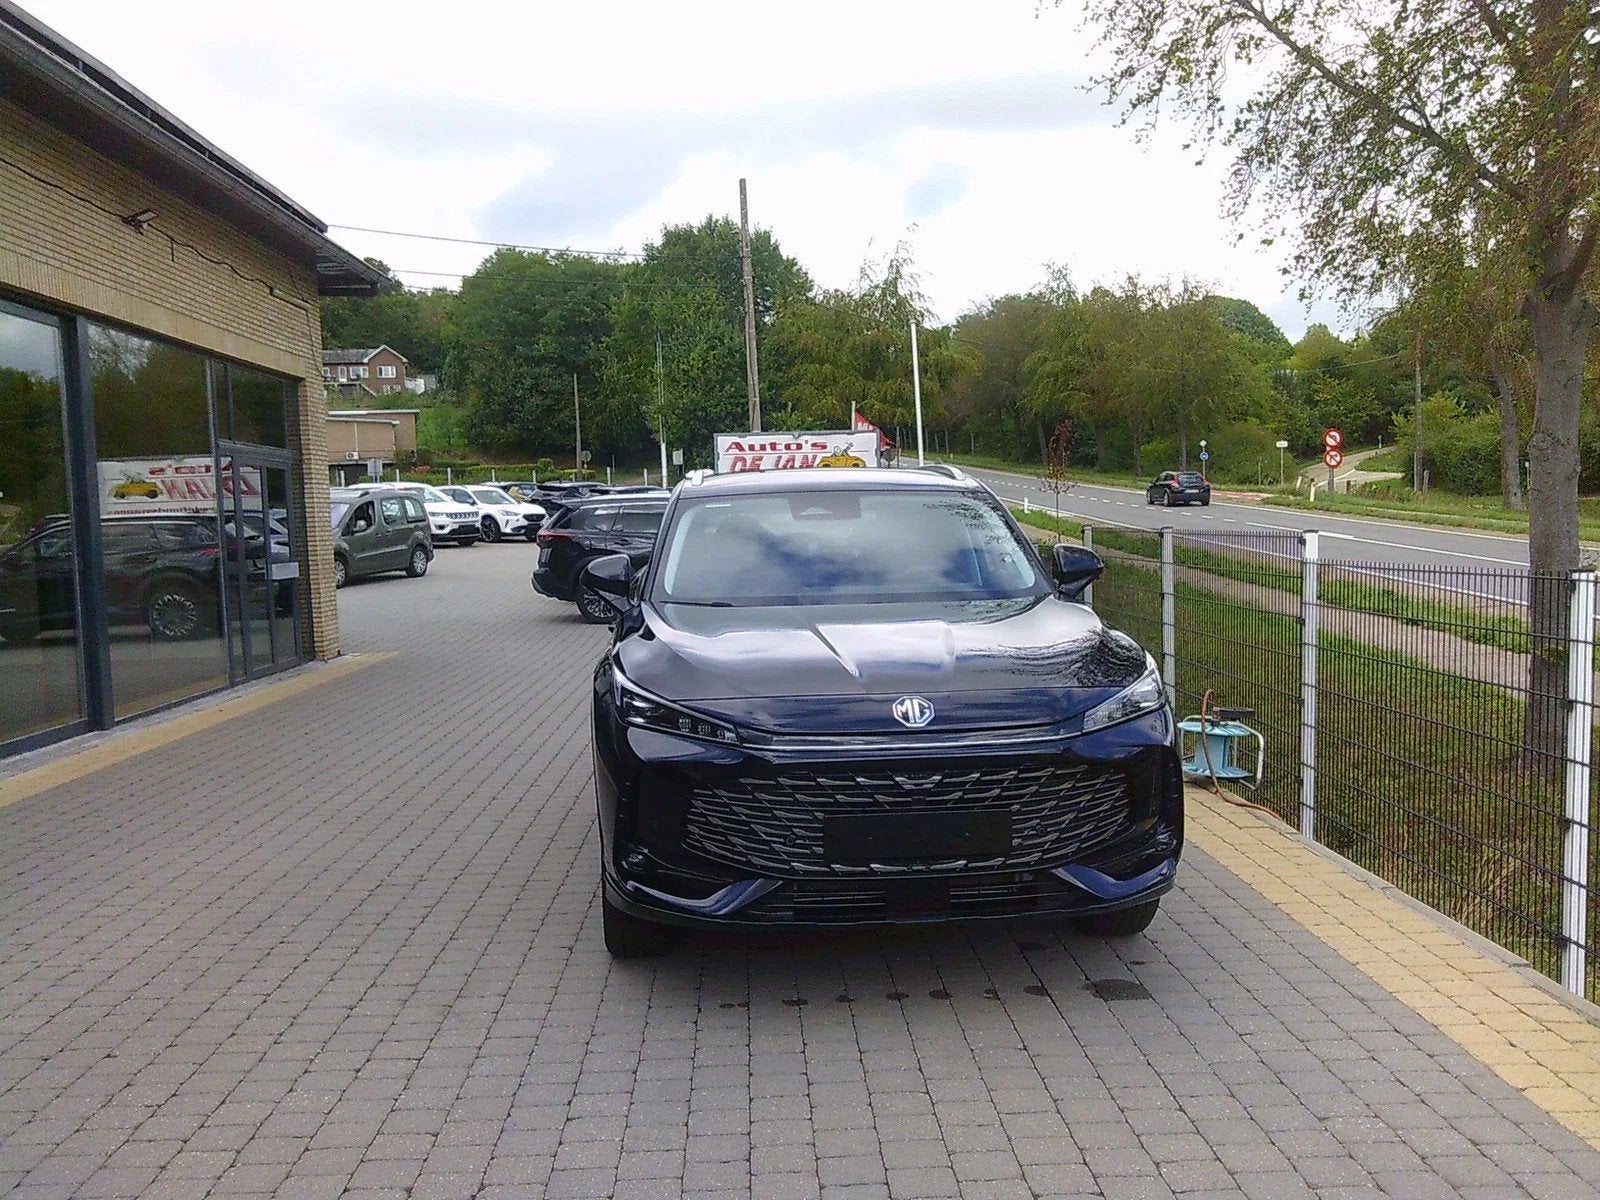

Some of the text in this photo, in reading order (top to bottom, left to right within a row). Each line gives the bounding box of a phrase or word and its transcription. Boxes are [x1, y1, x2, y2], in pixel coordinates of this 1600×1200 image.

[723, 439, 828, 453] Auto's
[729, 455, 764, 472] DE
[895, 698, 932, 724] MG
